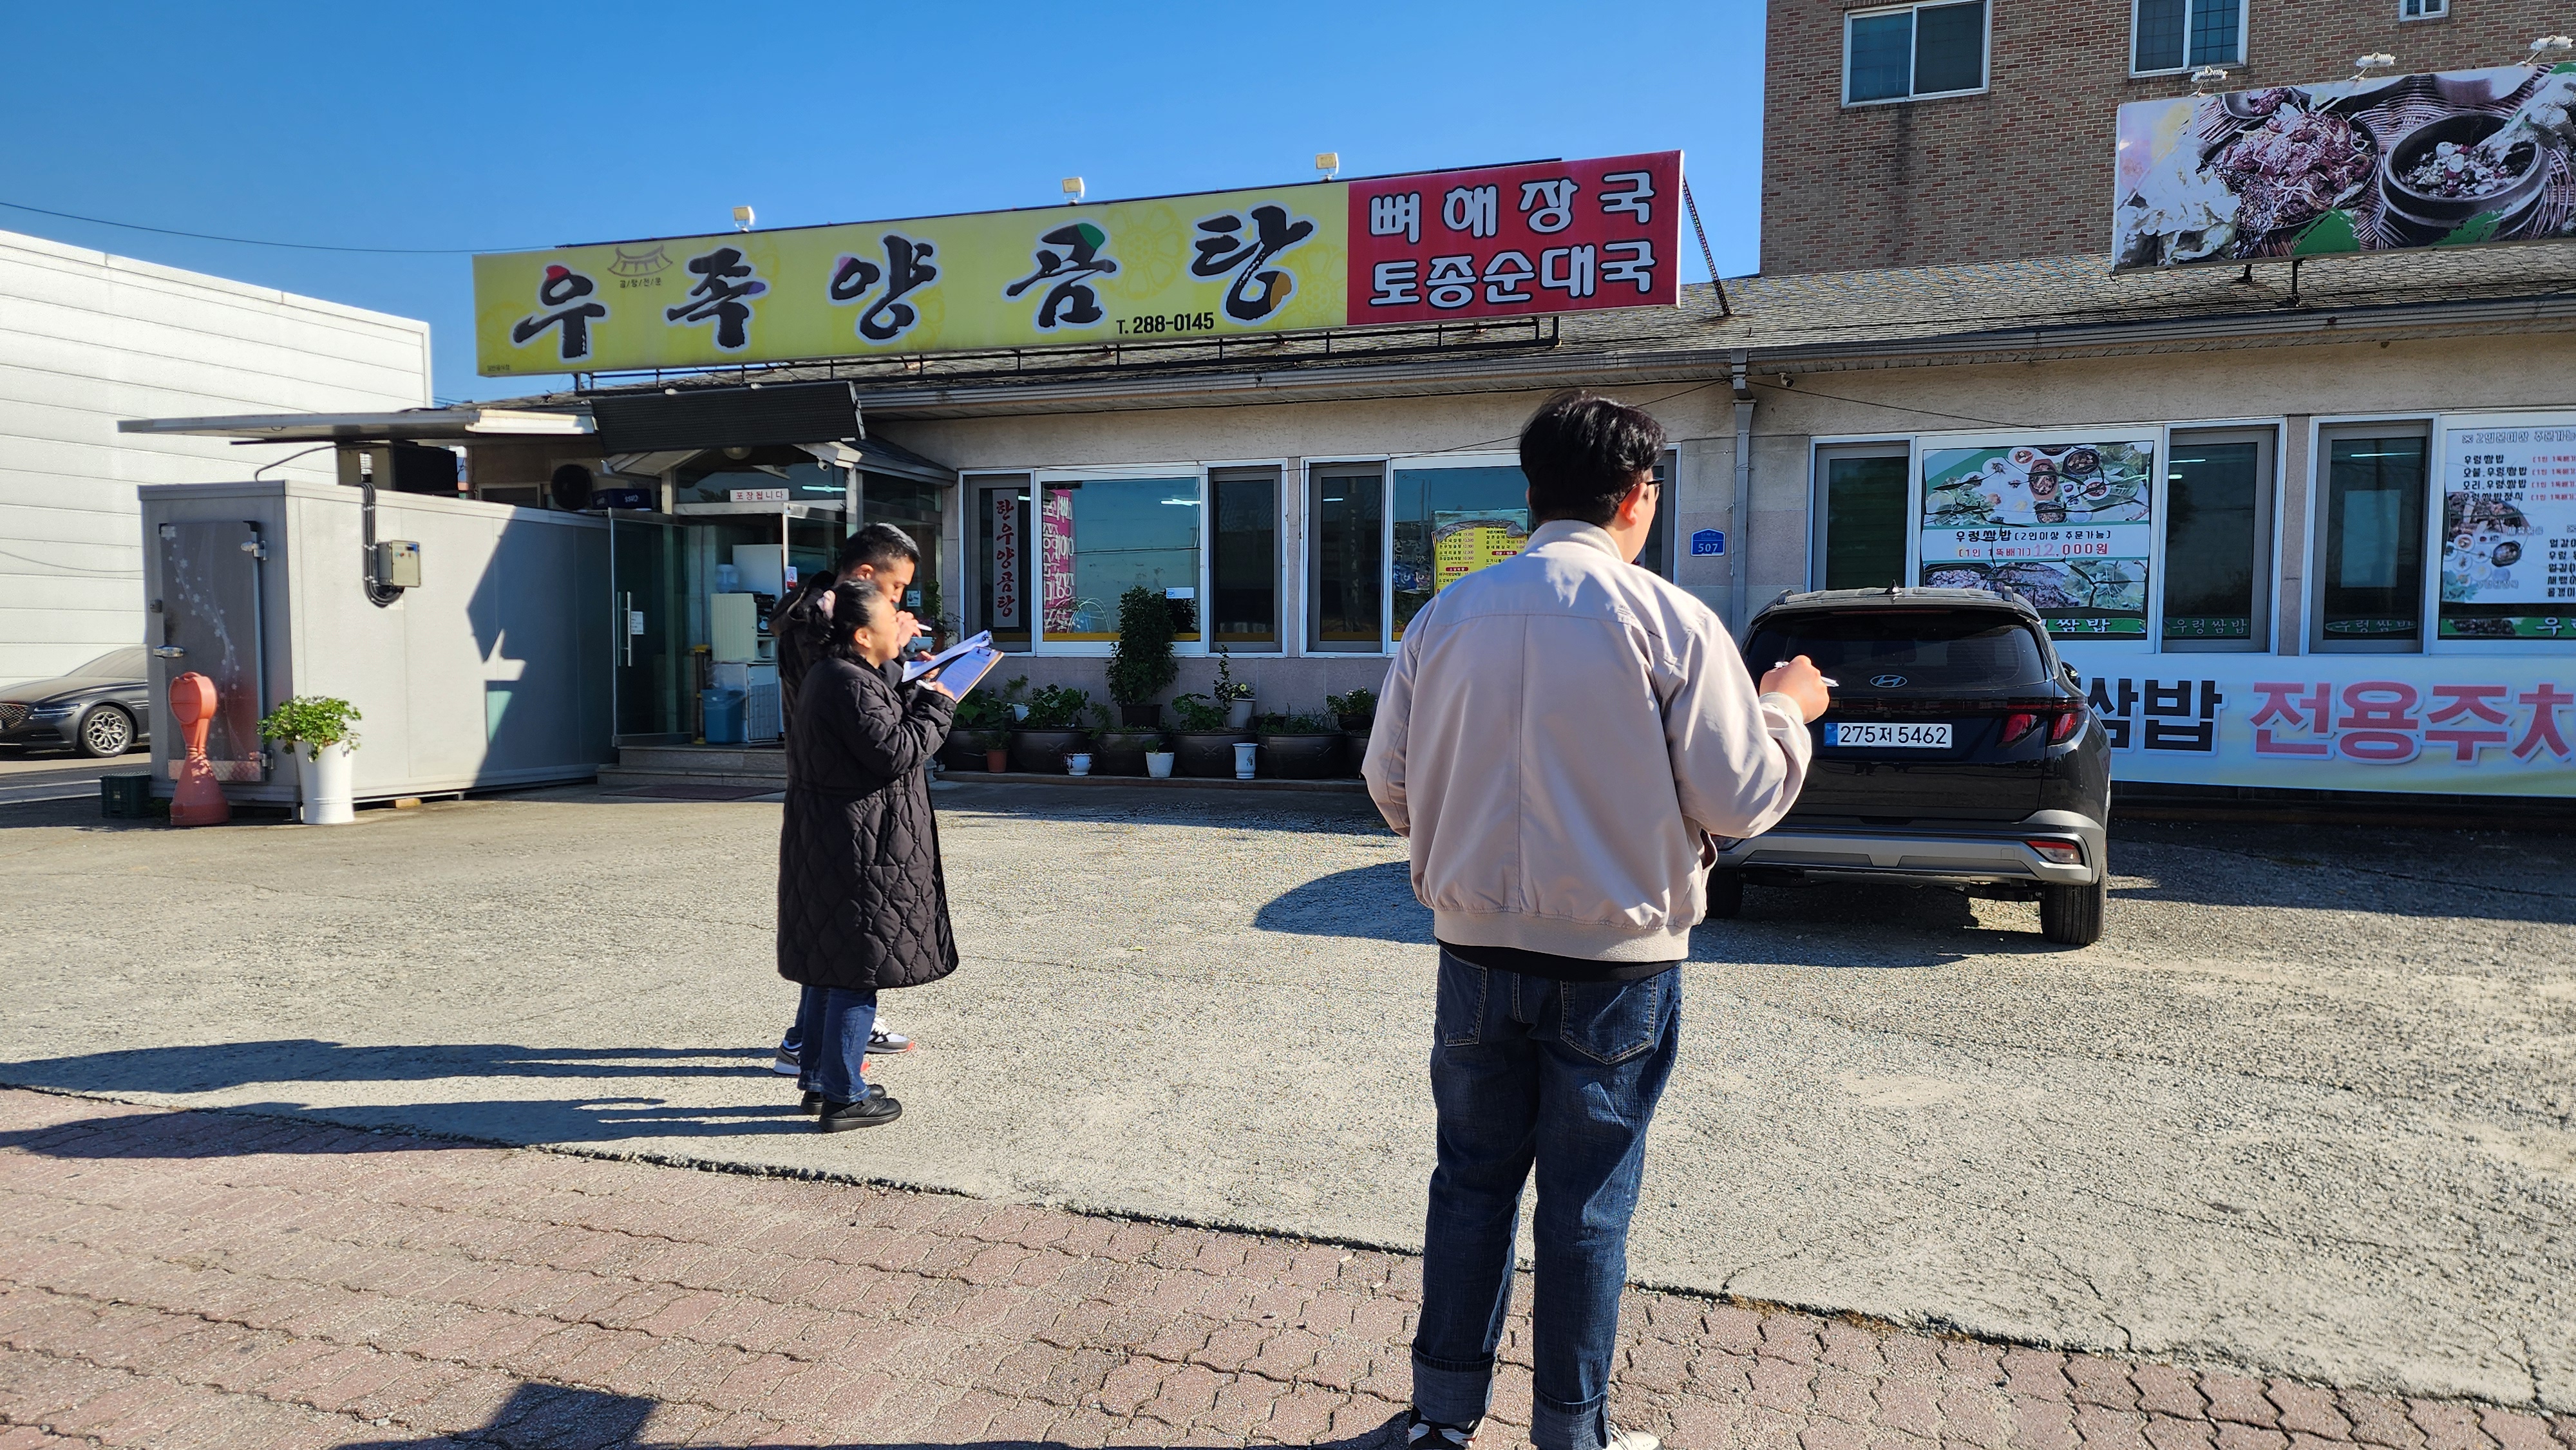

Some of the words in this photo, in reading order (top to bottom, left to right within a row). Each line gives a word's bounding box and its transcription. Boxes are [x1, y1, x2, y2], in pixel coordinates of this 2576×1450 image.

[1370, 170, 1656, 243] 뼈해장국
[513, 205, 1313, 359] 우족양곰탕
[1369, 239, 1656, 308] 토종순대국
[1133, 312, 1215, 334] 288-0145
[2465, 455, 2504, 464] 우렁쌈밥
[736, 491, 784, 500] 포장됩니다
[1956, 530, 2012, 542] 우렁쌈밥
[1698, 543, 1718, 552] 507
[996, 499, 1016, 617] 한우양곰탕
[2172, 619, 2248, 634] 우렁쌈밥
[1841, 726, 1892, 743] 275저
[1898, 726, 1947, 744] 5462
